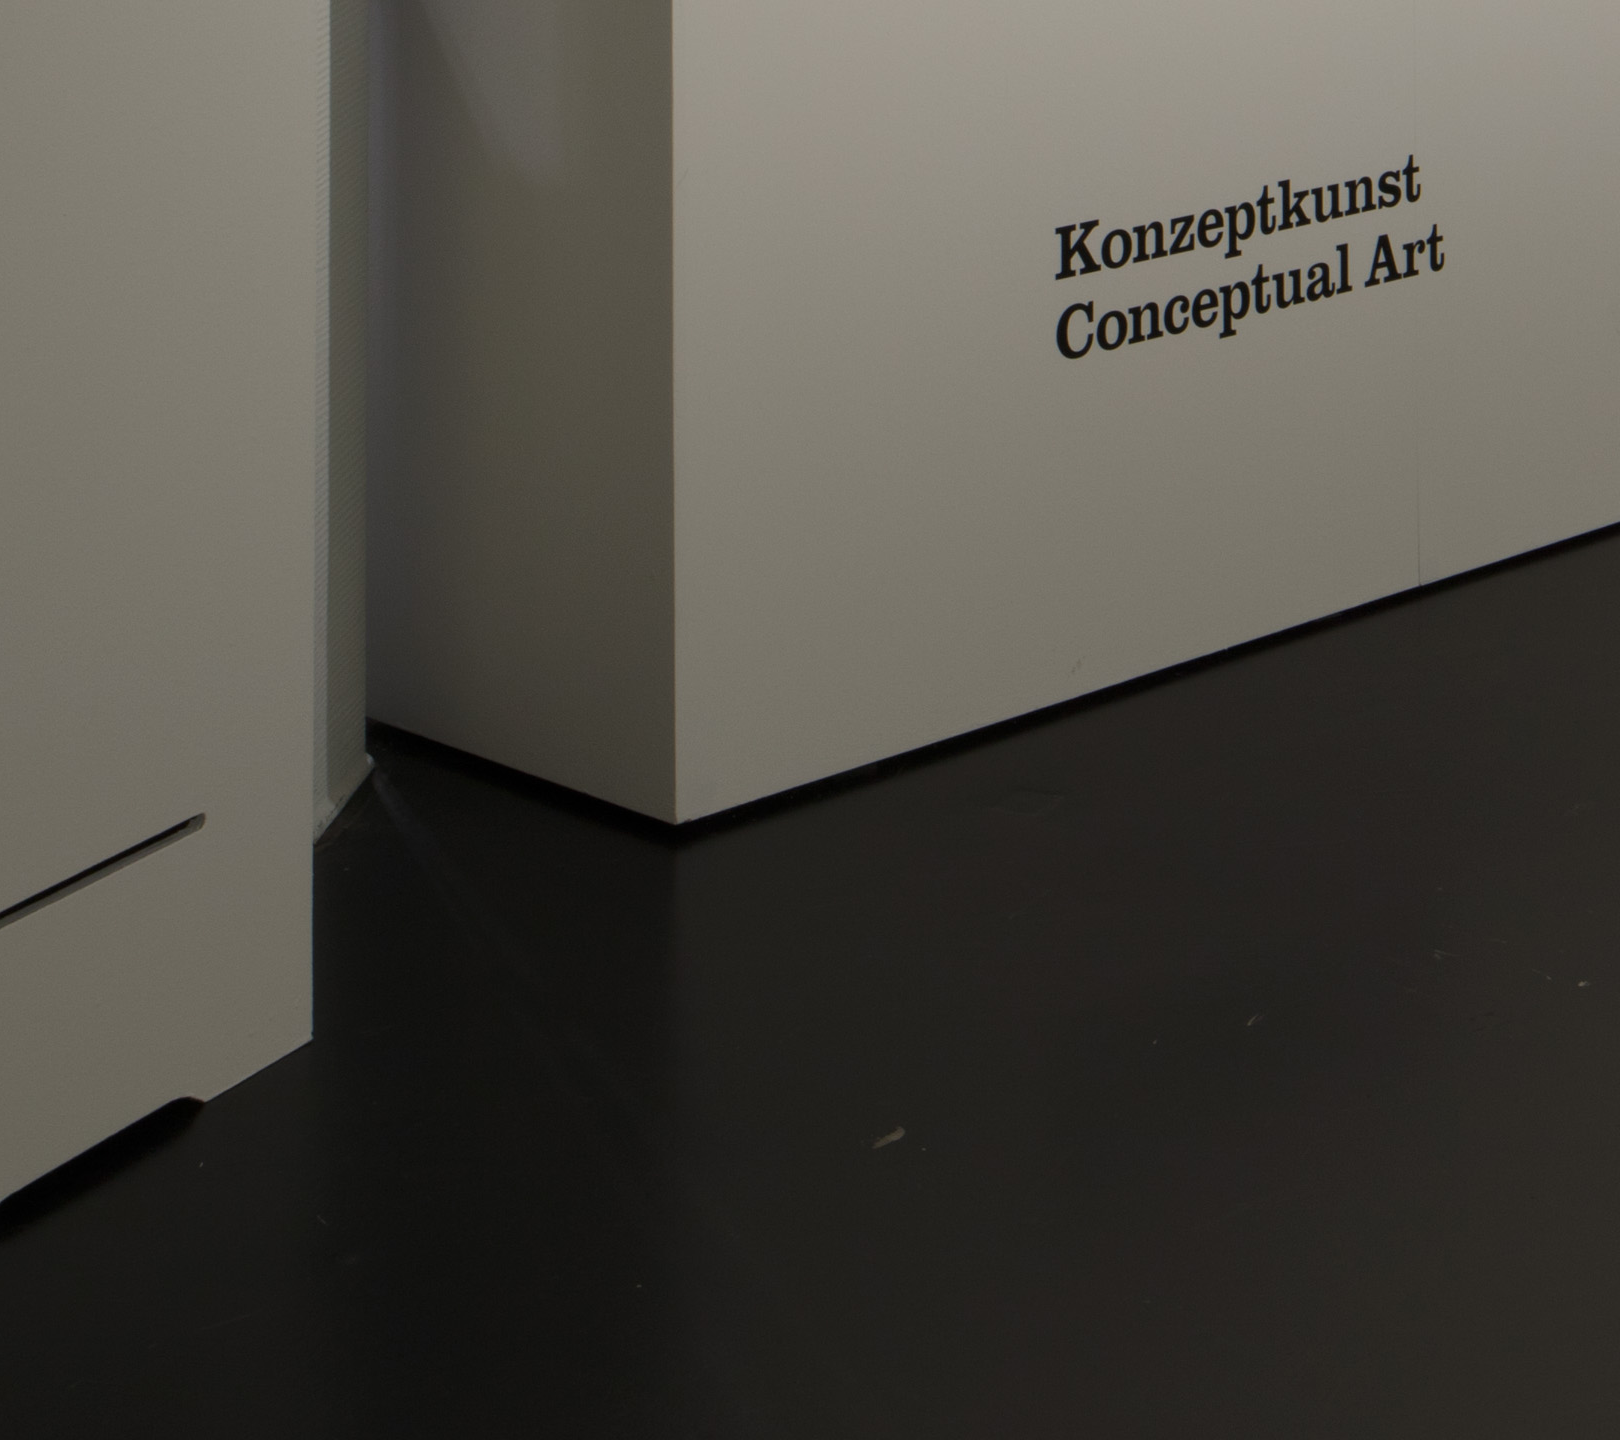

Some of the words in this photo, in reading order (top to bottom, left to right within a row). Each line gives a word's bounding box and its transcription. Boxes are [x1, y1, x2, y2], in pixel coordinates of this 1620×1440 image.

[1055, 154, 1421, 280] Konzeptkunst
[1056, 242, 1353, 360] Conceptual
[1364, 223, 1445, 288] Art
